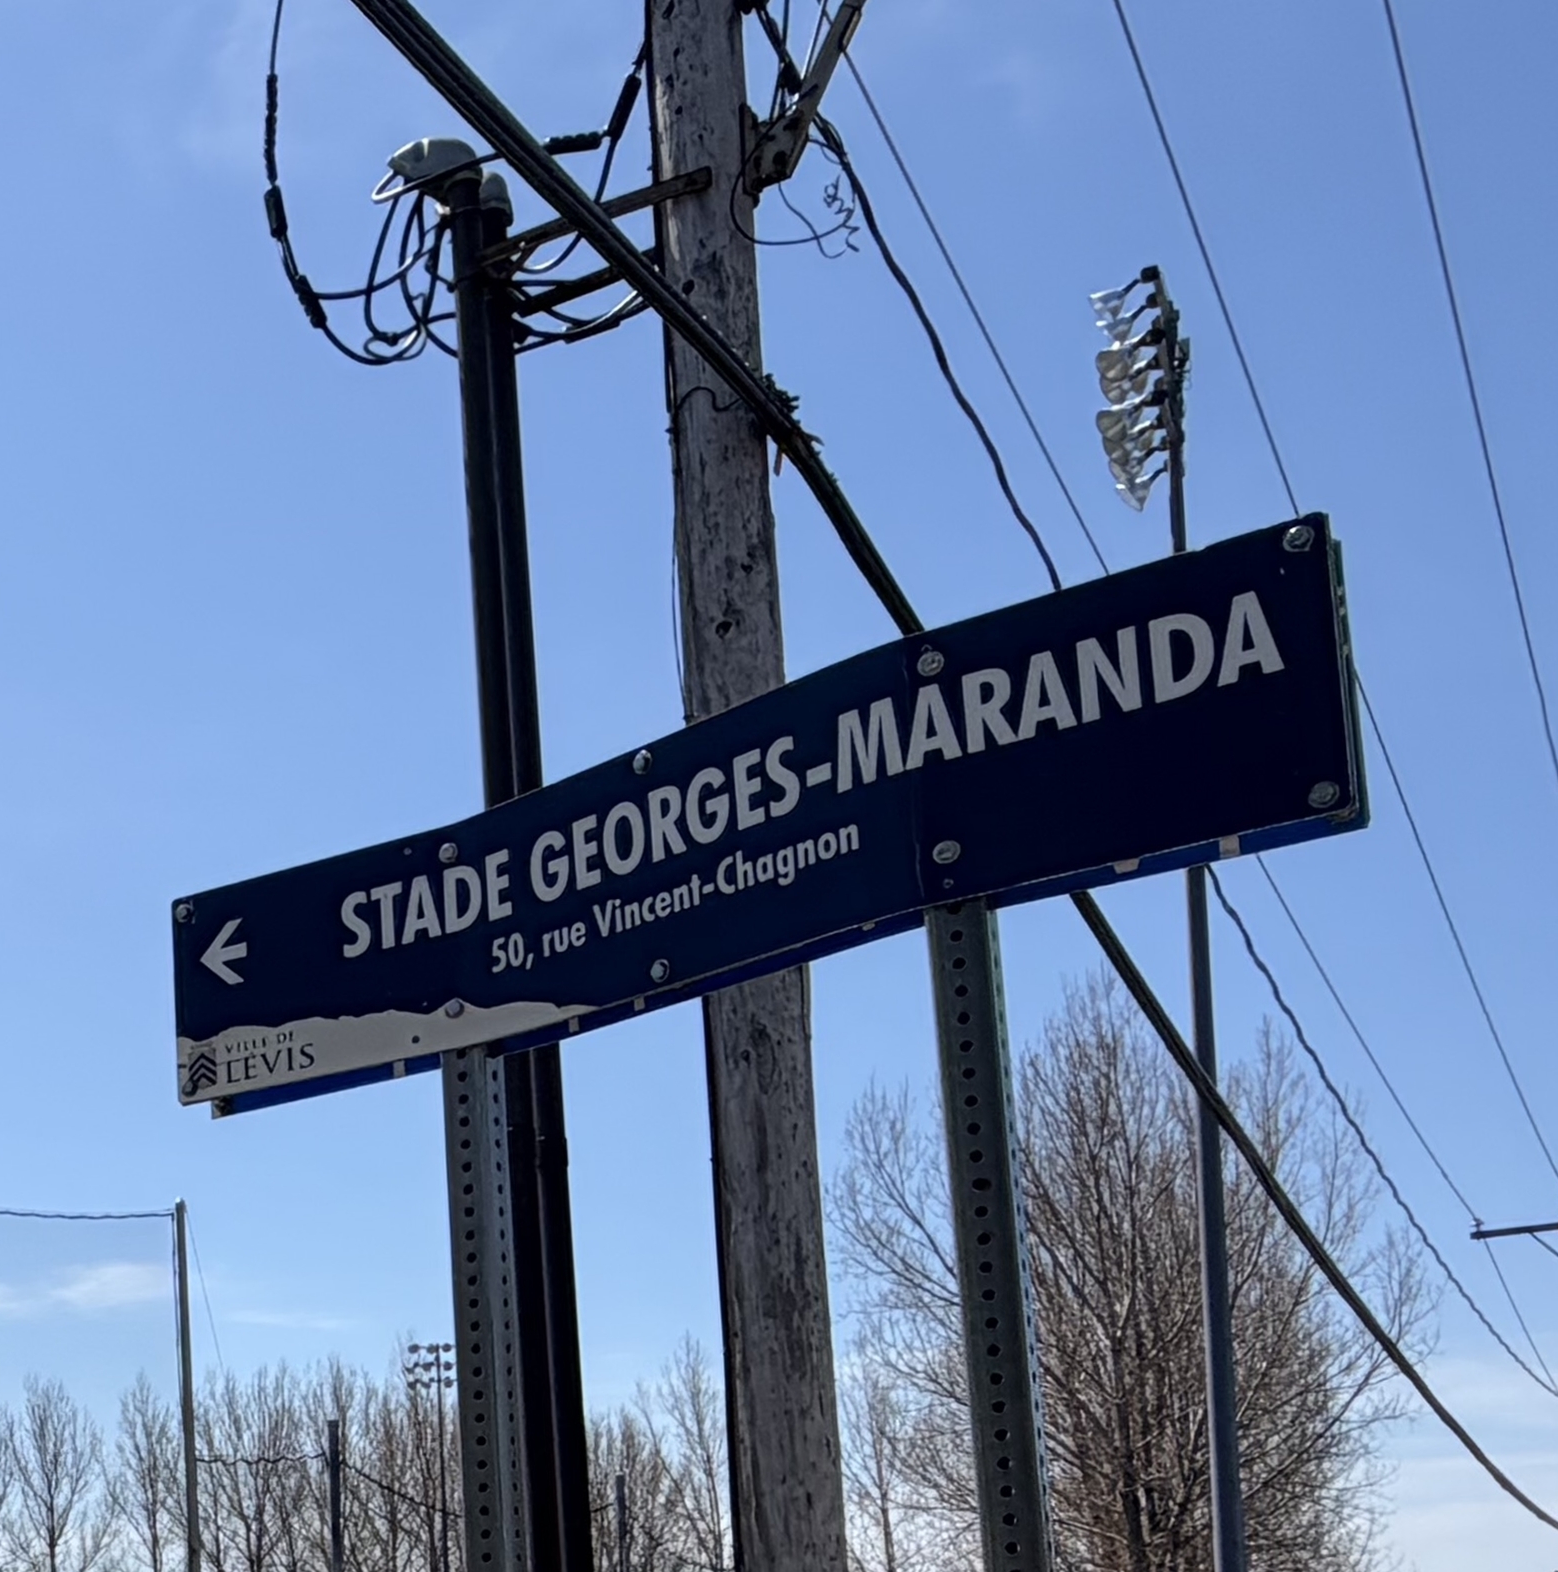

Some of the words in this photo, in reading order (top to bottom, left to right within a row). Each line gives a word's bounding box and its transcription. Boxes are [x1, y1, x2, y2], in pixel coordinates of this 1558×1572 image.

[340, 848, 513, 958] STADE
[529, 590, 1285, 903] GEORGES-MARANDA
[491, 932, 535, 974] 50,
[542, 921, 586, 958] rue
[592, 823, 860, 938] Vincent-Chagnon
